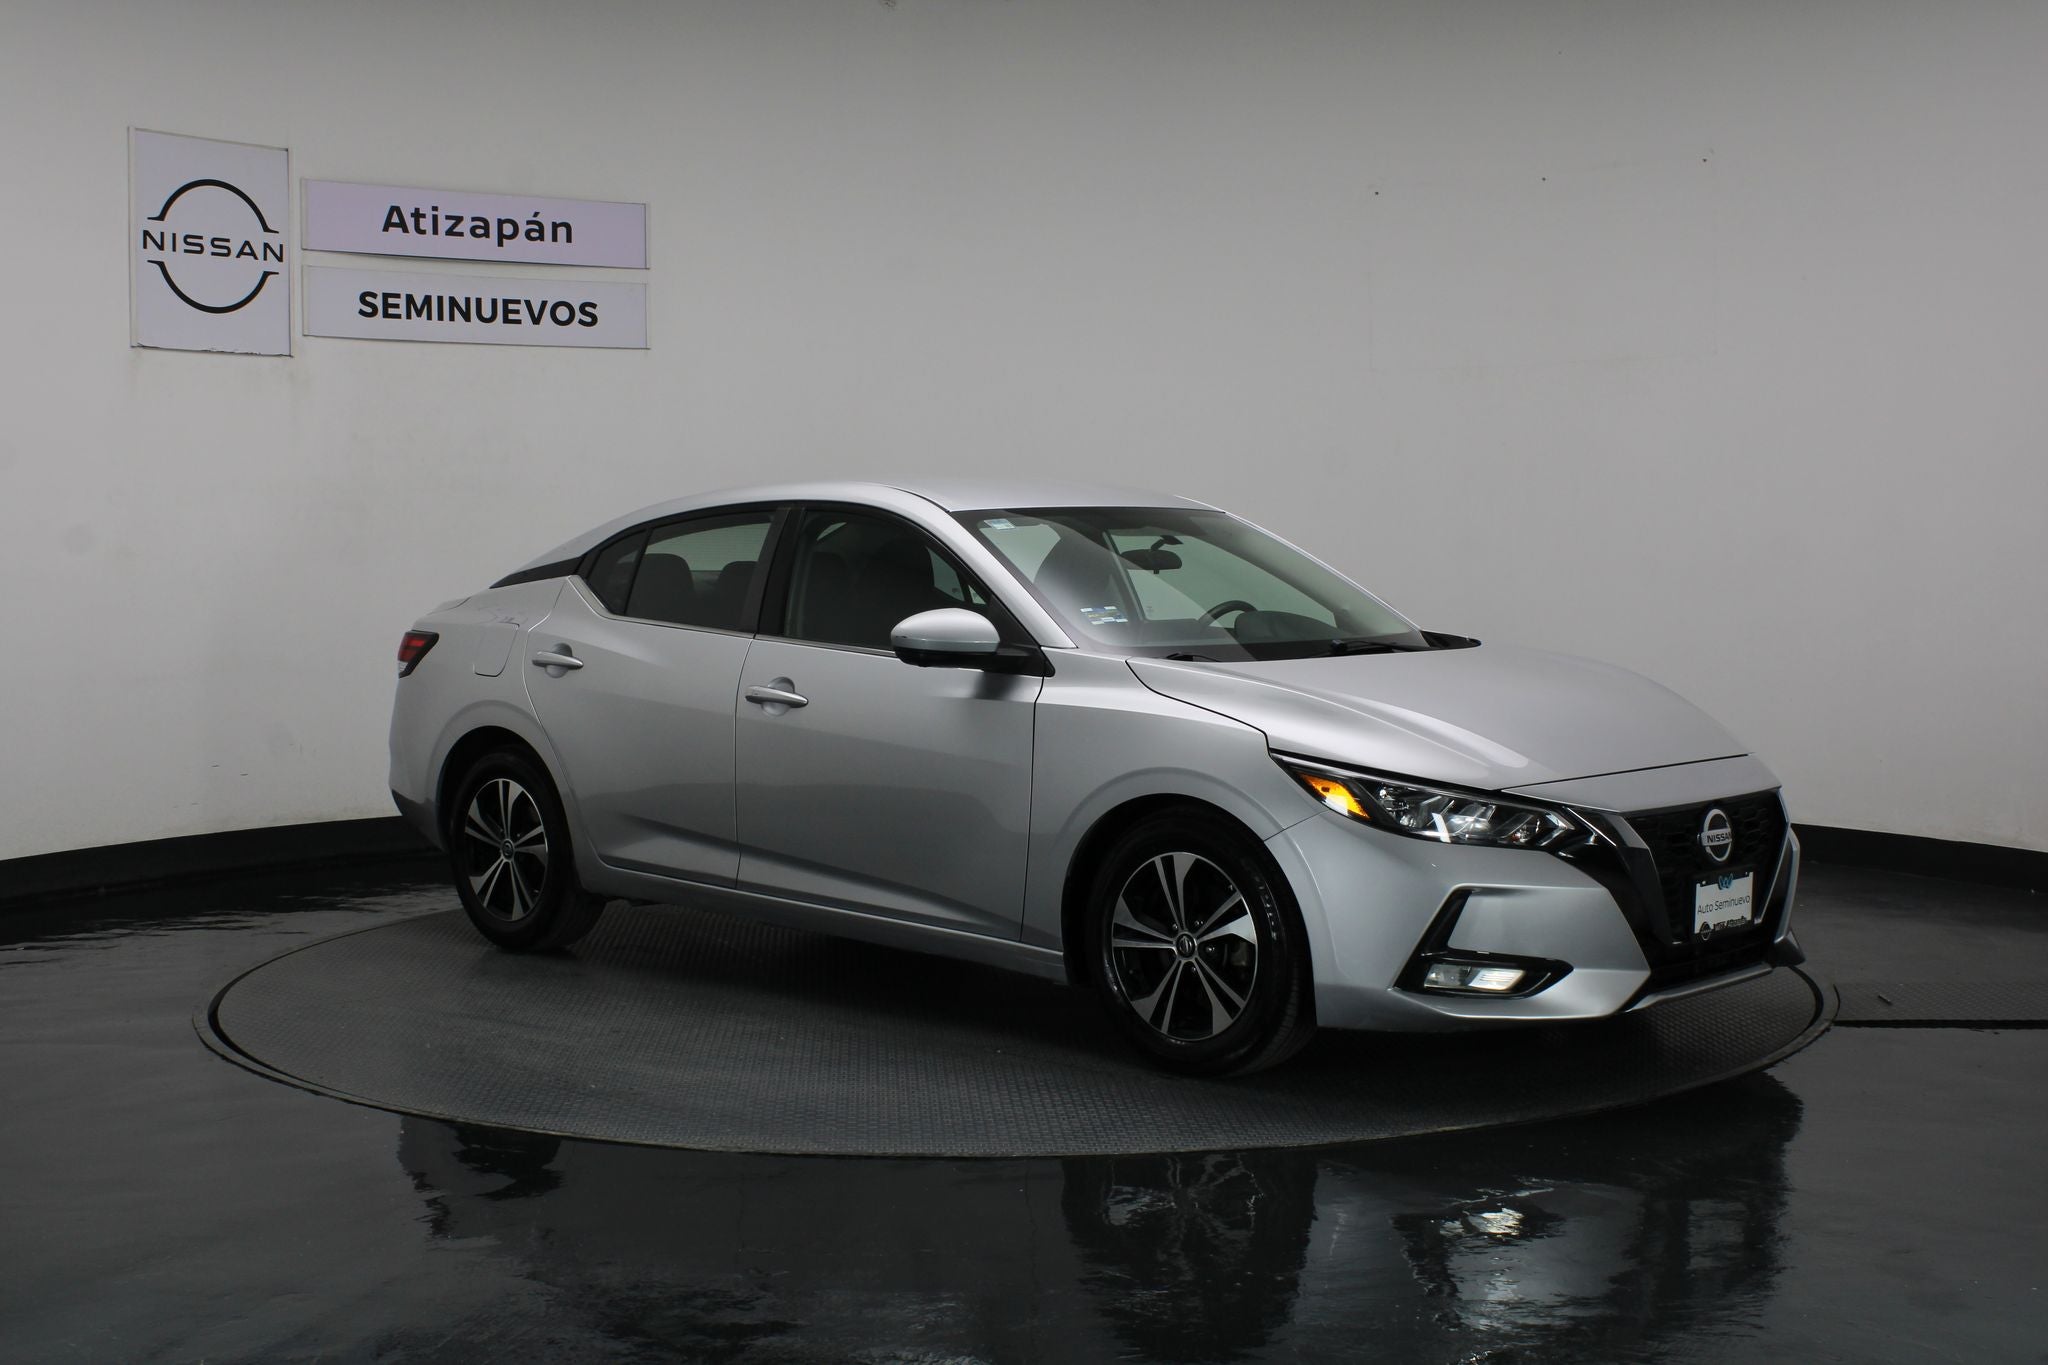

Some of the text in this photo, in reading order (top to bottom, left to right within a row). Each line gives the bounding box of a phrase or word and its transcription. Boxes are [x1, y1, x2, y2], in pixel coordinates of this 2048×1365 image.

[382, 205, 573, 247] Atizapán
[142, 229, 284, 263] NISSAN
[358, 290, 598, 327] SEMINUEVOS
[1697, 895, 1751, 914] Auto Seminuevo
